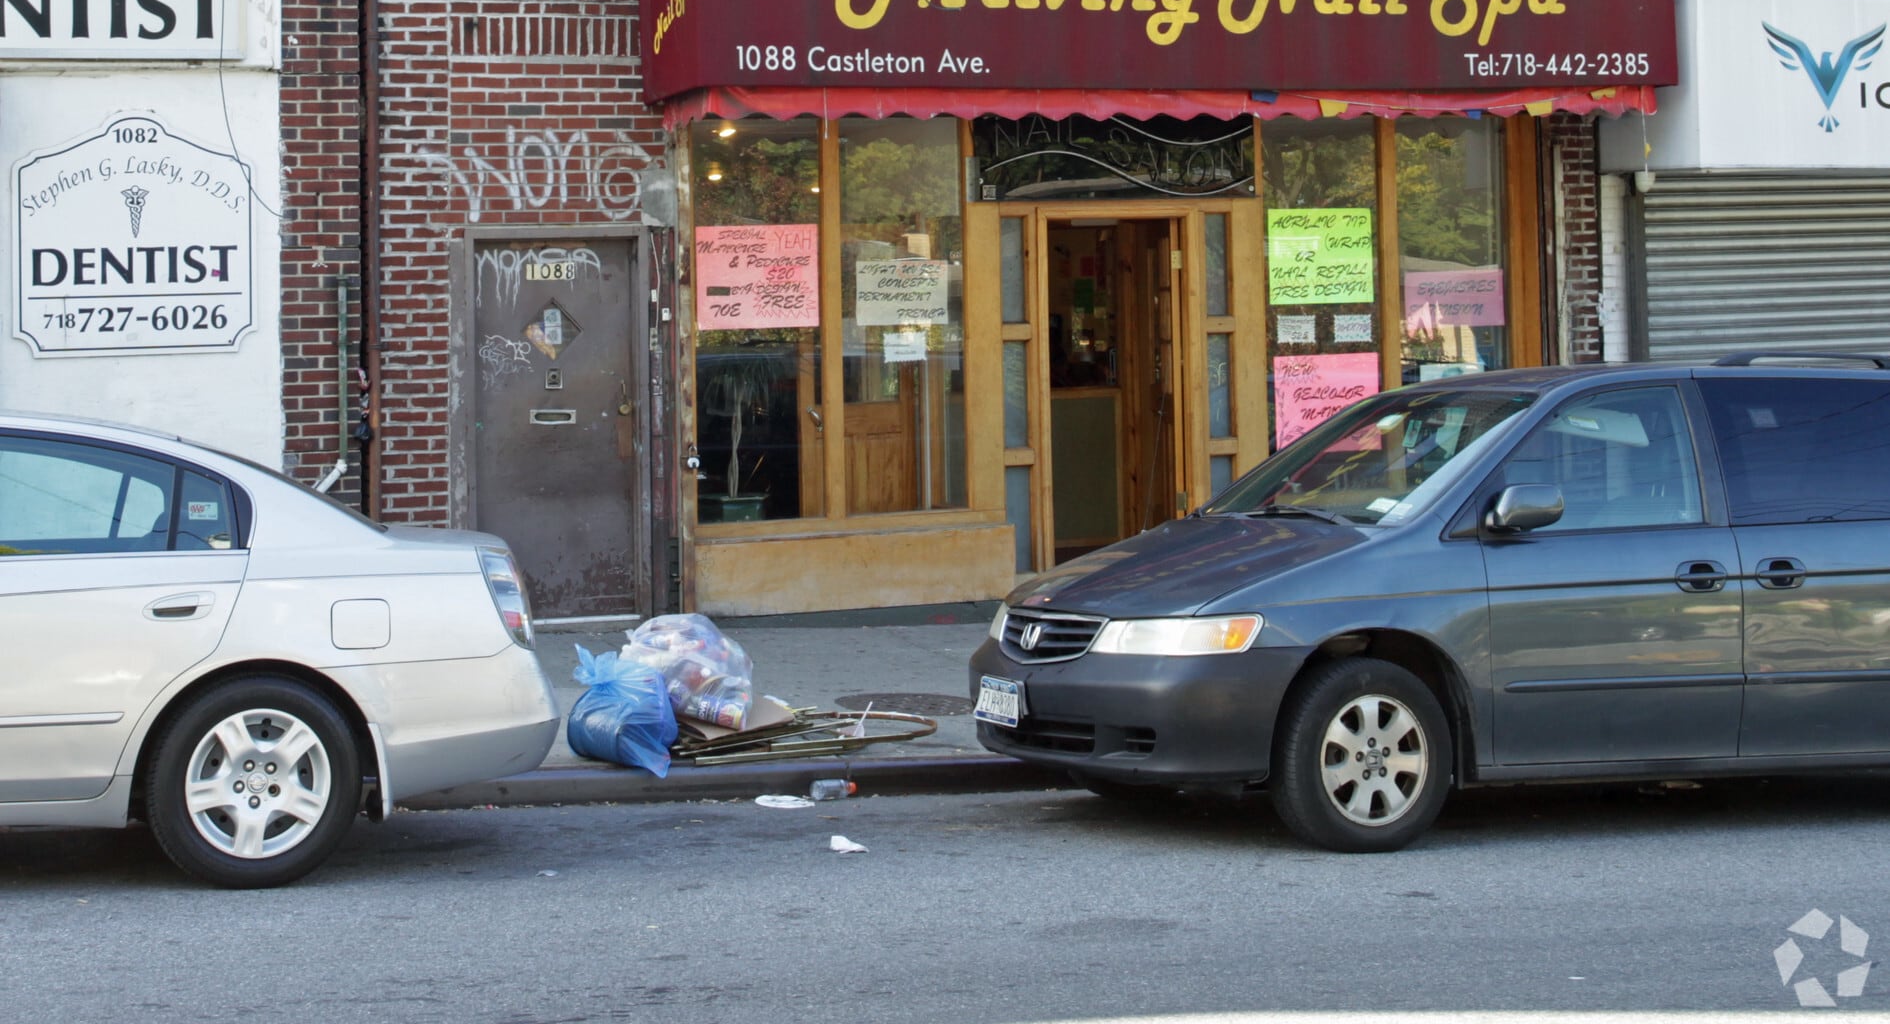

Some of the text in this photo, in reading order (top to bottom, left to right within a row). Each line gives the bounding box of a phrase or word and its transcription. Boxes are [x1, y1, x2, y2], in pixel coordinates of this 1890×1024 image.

[736, 44, 991, 75] 1088 Castleton Ave.
[1463, 52, 1650, 77] Tel:718-442-2385
[113, 127, 158, 144] 1082
[994, 115, 1244, 187] NAIL SALON
[21, 155, 246, 217] Stephen G. Lasky, D.D.S.
[1272, 215, 1368, 230] ACRYLIC TIP
[775, 230, 811, 251] YEAH
[729, 255, 739, 268] &
[1295, 251, 1316, 263] OR
[32, 245, 238, 287] DENTIST
[530, 263, 574, 280] 1088
[766, 267, 795, 281] $20
[1272, 262, 1369, 279] NAIL REFILL
[858, 291, 932, 302] PERMANENT
[1272, 279, 1368, 301] FREE DESIGN
[1417, 279, 1497, 297] EYELASHES
[711, 302, 742, 318] TOE
[761, 294, 806, 309] FREE
[896, 307, 946, 319] FRENCH
[1282, 362, 1314, 377] NEW
